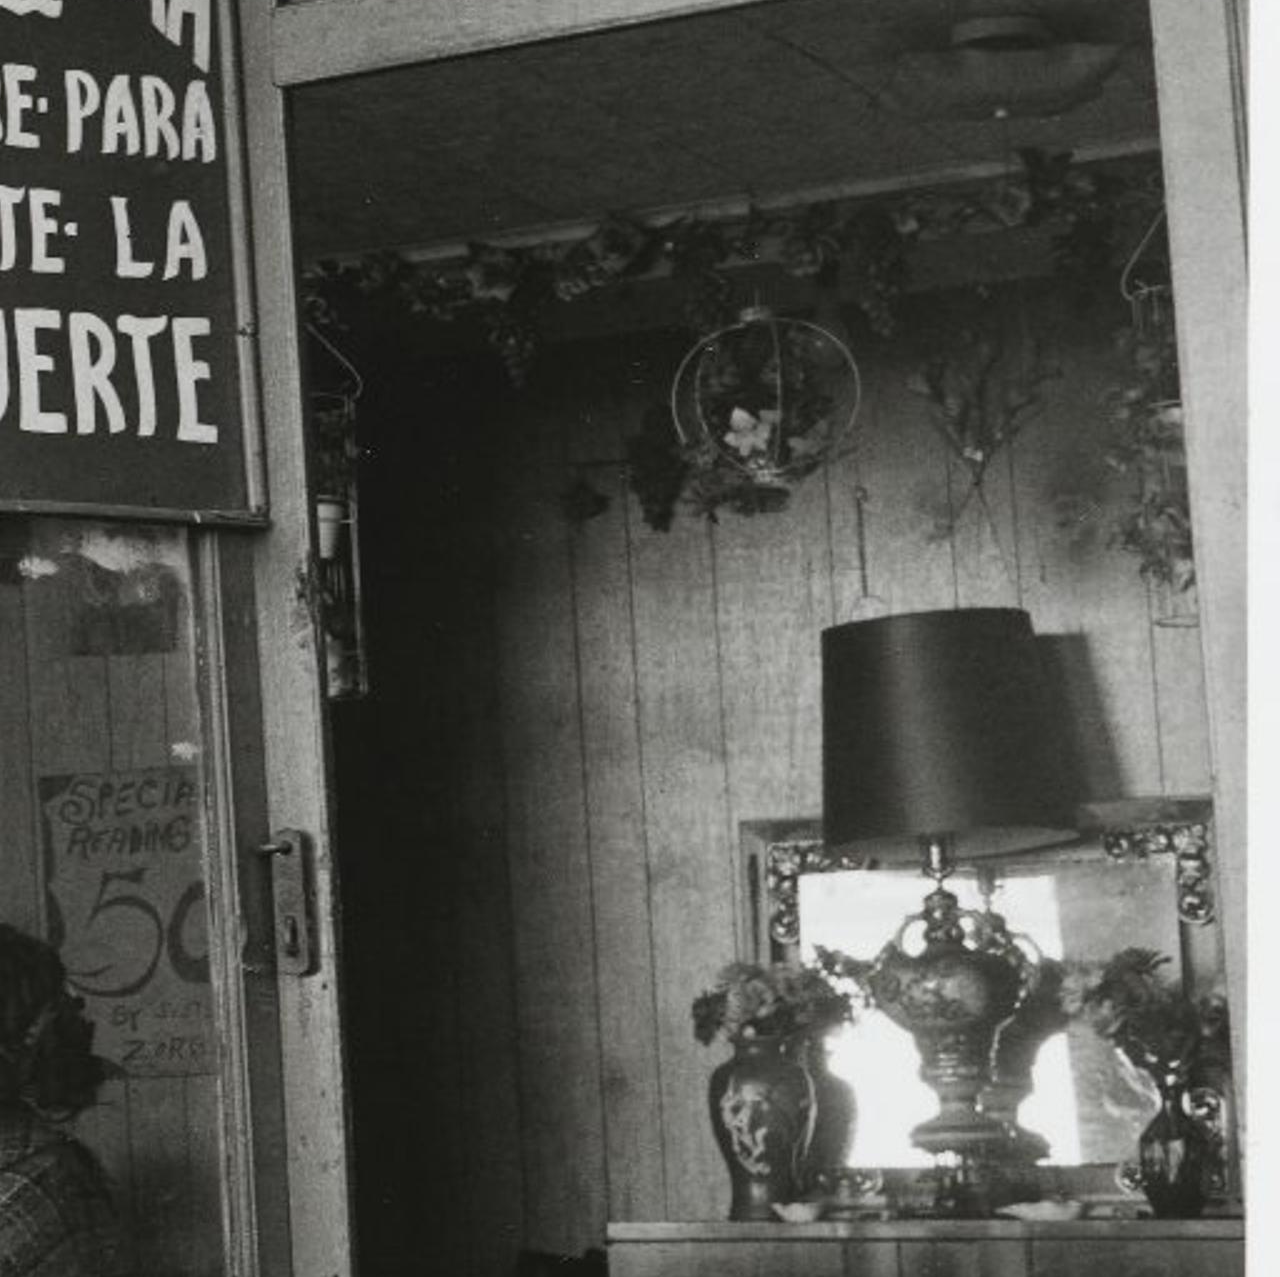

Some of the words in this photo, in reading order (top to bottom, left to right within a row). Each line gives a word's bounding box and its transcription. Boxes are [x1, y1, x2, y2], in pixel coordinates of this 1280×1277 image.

[63, 68, 217, 165] PARA
[110, 196, 208, 281] LA
[58, 779, 195, 827] SPECIA
